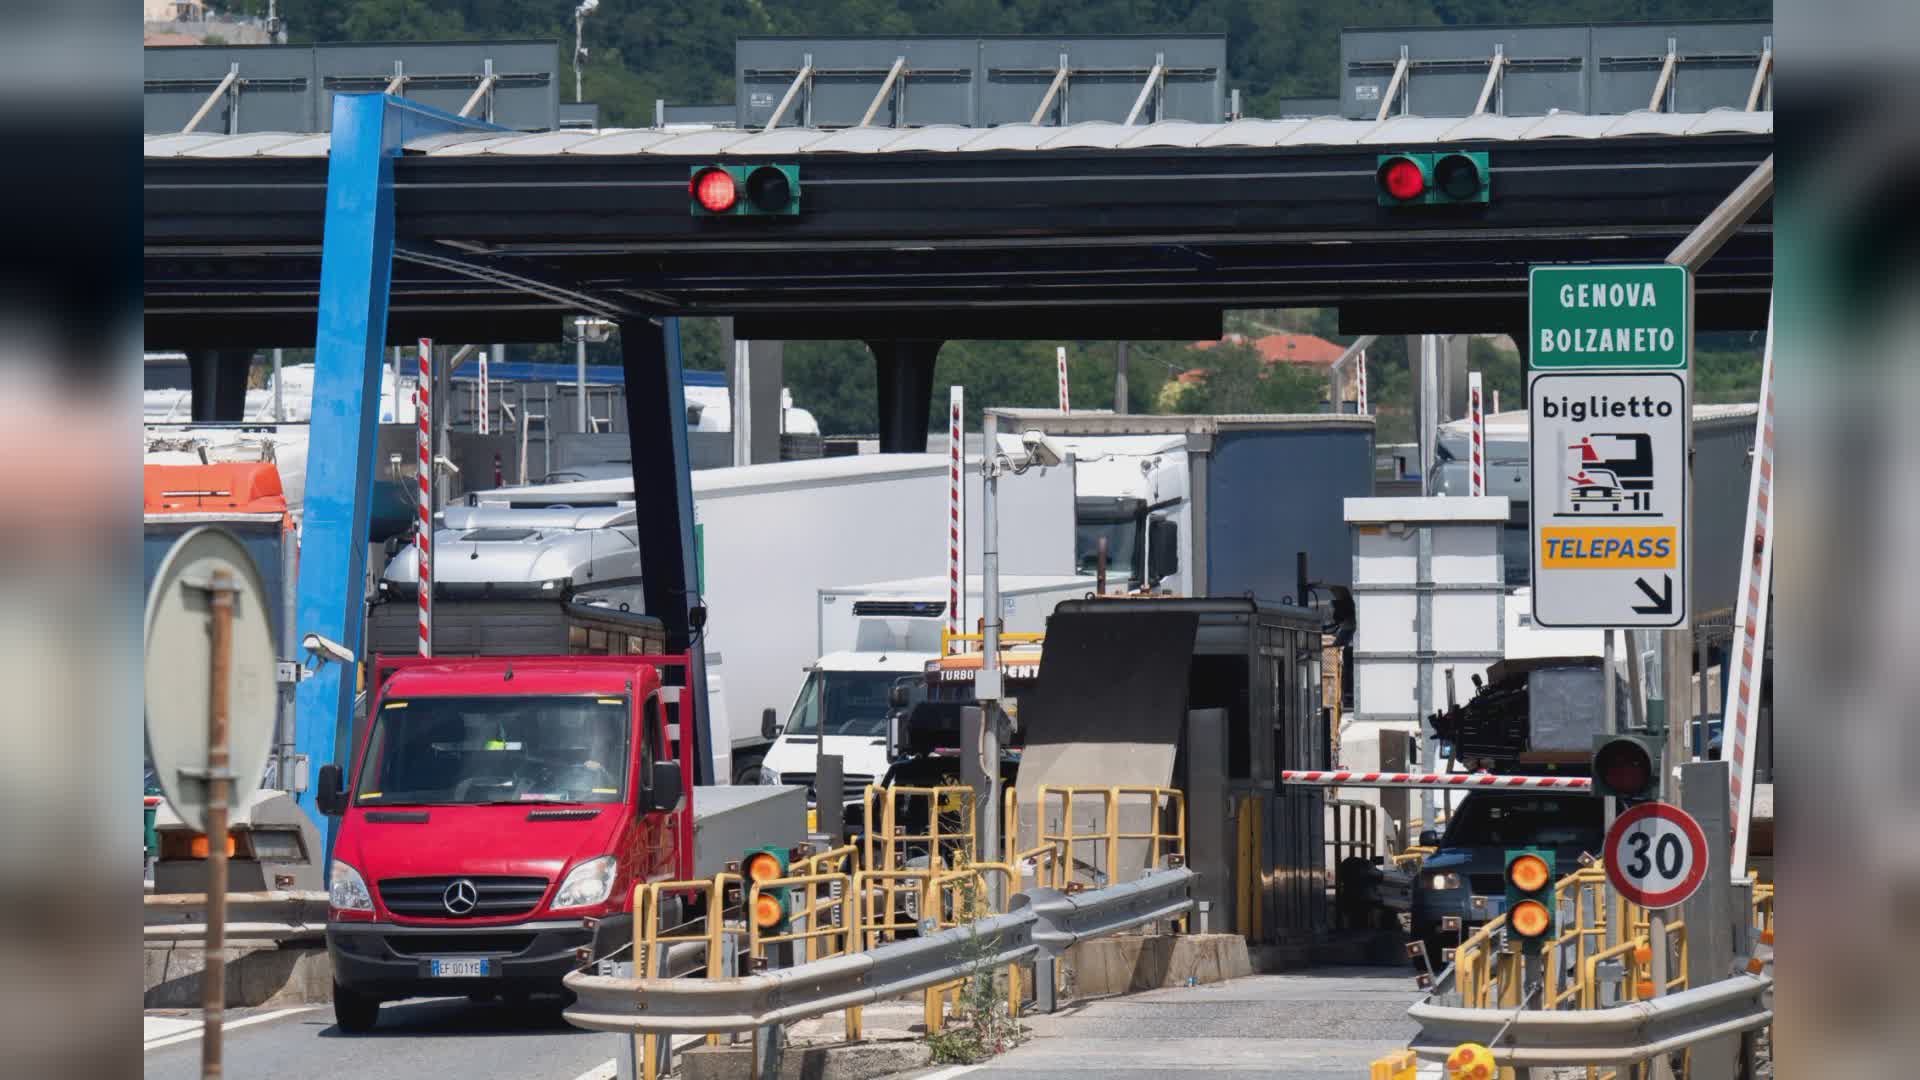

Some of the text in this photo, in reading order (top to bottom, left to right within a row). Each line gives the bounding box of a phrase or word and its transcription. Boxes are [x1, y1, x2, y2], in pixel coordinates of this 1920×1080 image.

[1559, 283, 1657, 308] GENOVA
[1540, 328, 1675, 353] BOLZANETO
[1543, 395, 1673, 422] biglietto
[1545, 537, 1671, 558] TELEPASS
[940, 669, 974, 681] TURBO
[1626, 831, 1684, 880] 30
